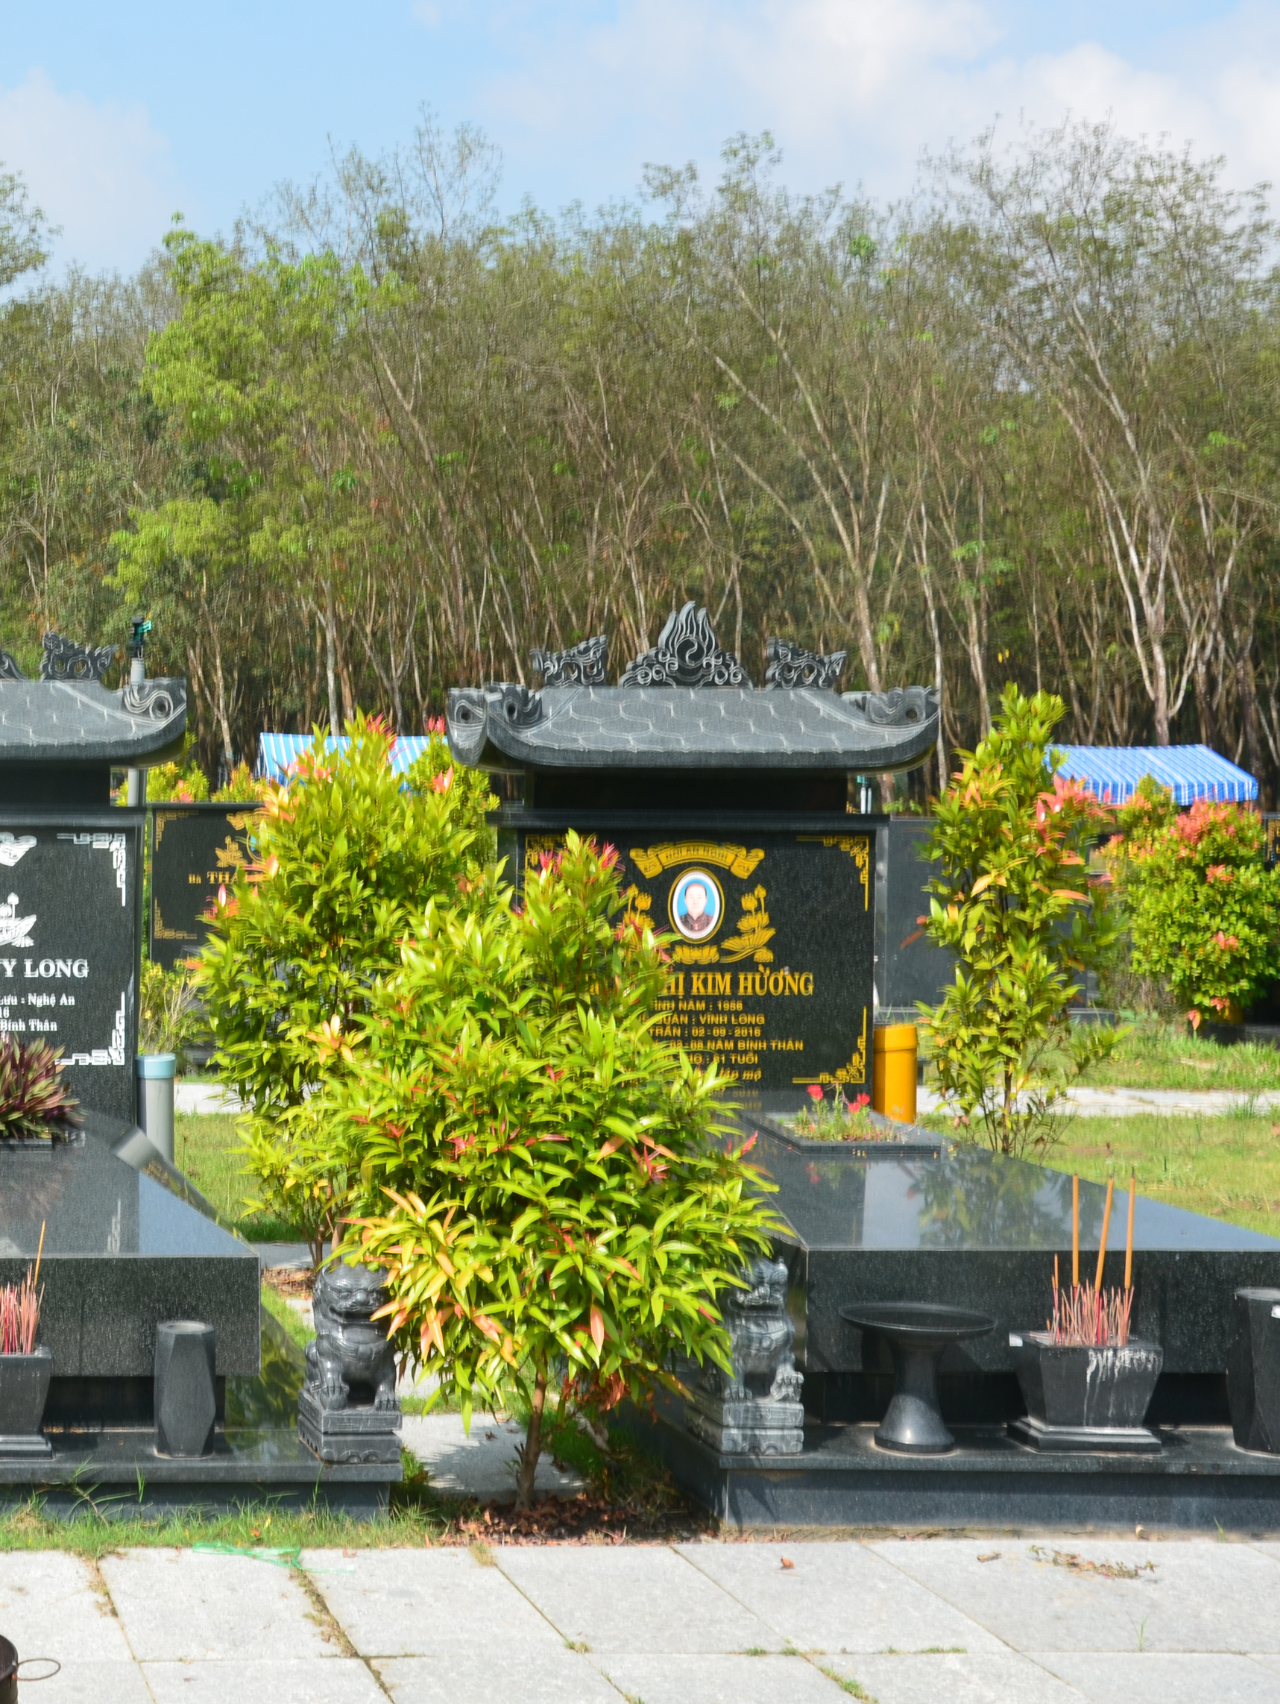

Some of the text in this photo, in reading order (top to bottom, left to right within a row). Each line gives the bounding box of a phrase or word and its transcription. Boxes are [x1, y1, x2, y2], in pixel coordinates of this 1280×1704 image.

[24, 958, 90, 978] LONG
[691, 971, 732, 996] KIM
[28, 993, 56, 1007] Nghệ
[59, 993, 76, 1005] An
[731, 1013, 765, 1025] LONG
